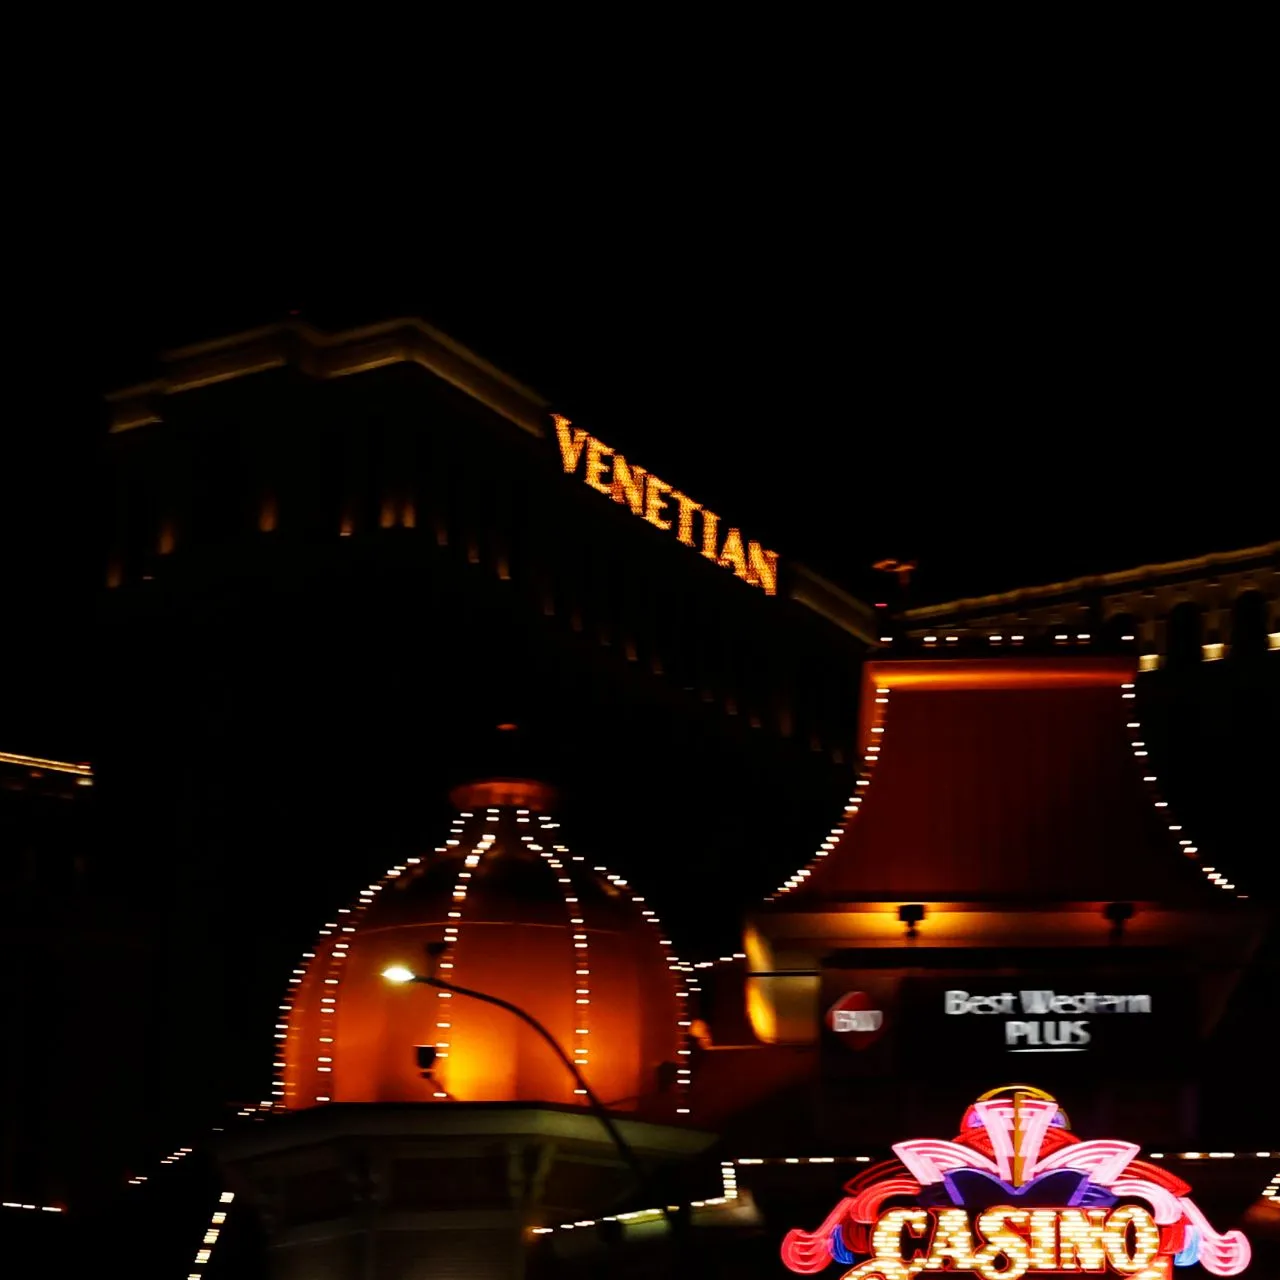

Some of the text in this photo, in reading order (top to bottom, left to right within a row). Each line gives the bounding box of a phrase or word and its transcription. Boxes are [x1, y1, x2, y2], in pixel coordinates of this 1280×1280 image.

[550, 413, 780, 595] VENETIAN
[945, 990, 1151, 1014] Best Western
[1004, 1020, 1091, 1045] PLUS
